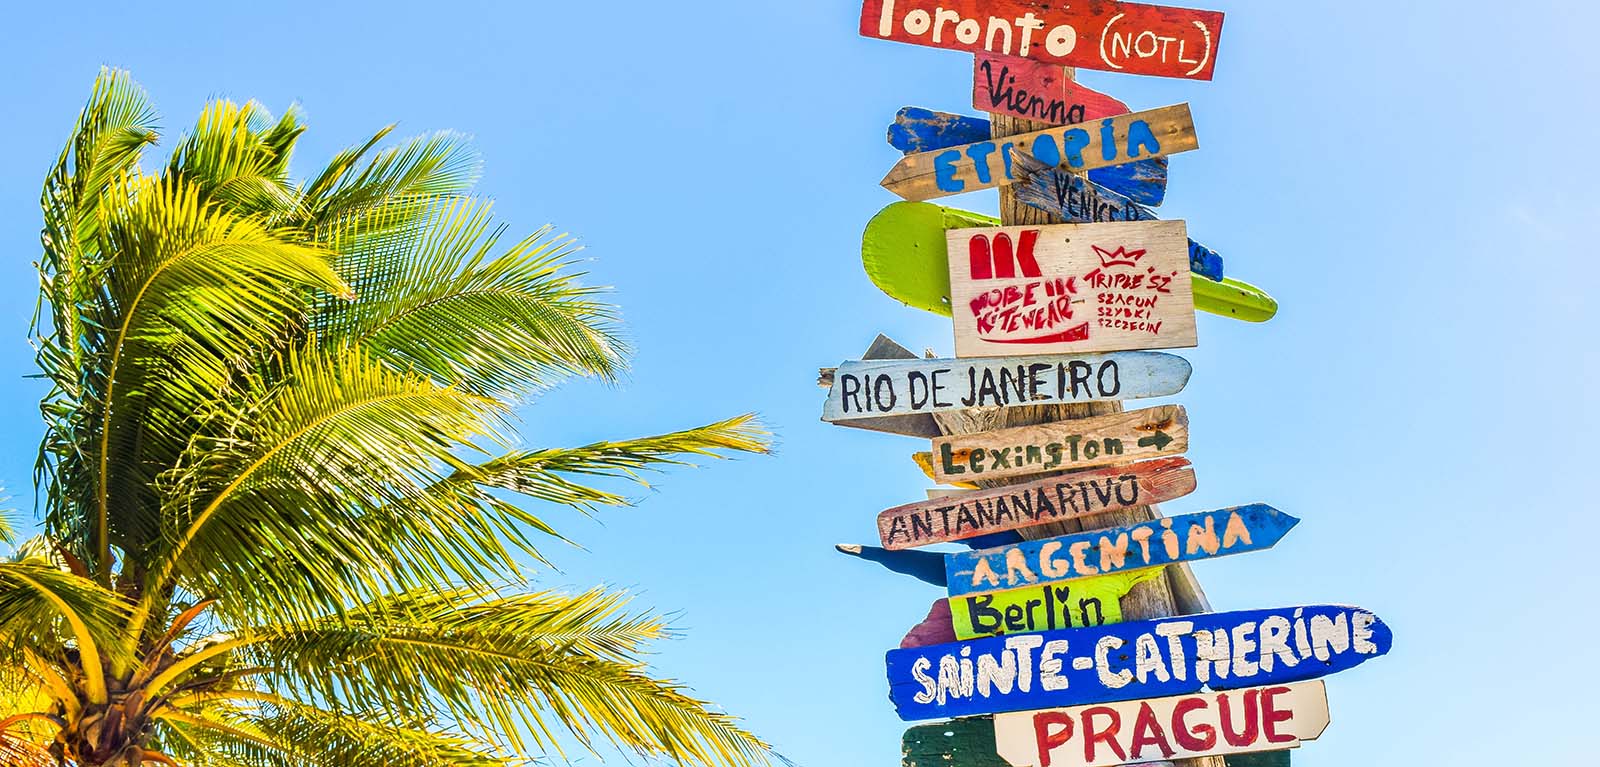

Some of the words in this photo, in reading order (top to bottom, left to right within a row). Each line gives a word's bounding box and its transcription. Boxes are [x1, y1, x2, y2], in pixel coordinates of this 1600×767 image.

[879, 0, 1077, 57] Toronto
[1099, 13, 1211, 76] (NOTL)
[980, 60, 1086, 125] Vienna
[1083, 268, 1145, 290] TRIPLE
[841, 373, 897, 413] RIO
[908, 369, 953, 410] DE
[961, 360, 1121, 407] JANEIRO
[940, 434, 1124, 475] Lexington
[888, 474, 1139, 544] ANTANANARIVO
[965, 585, 1105, 634] Berlin
[1033, 686, 1301, 767] PRAGUE
